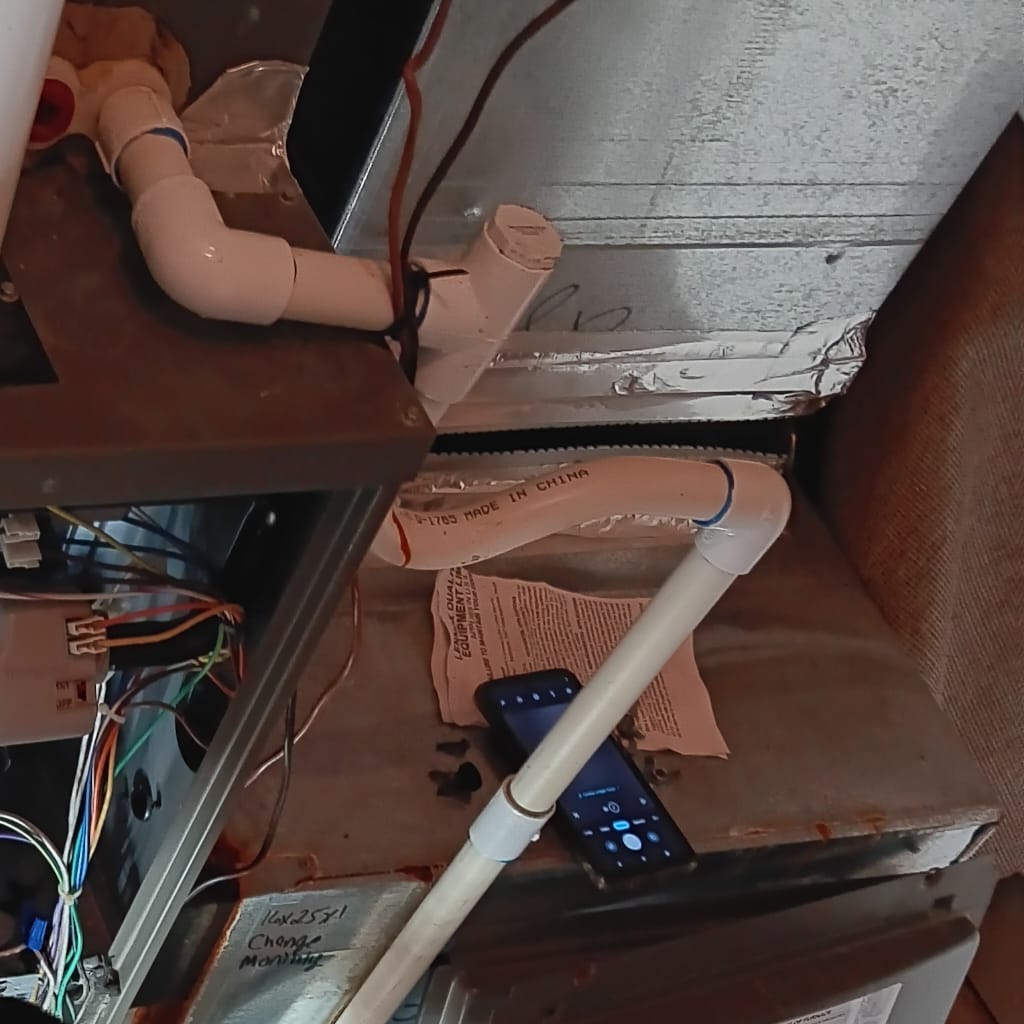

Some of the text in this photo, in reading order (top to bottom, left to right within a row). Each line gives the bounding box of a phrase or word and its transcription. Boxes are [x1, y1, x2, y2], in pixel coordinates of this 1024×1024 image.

[464, 501, 500, 521] MADE
[508, 489, 527, 503] IN
[536, 468, 590, 492] CHINA
[455, 588, 472, 658] EQUIPMENT
